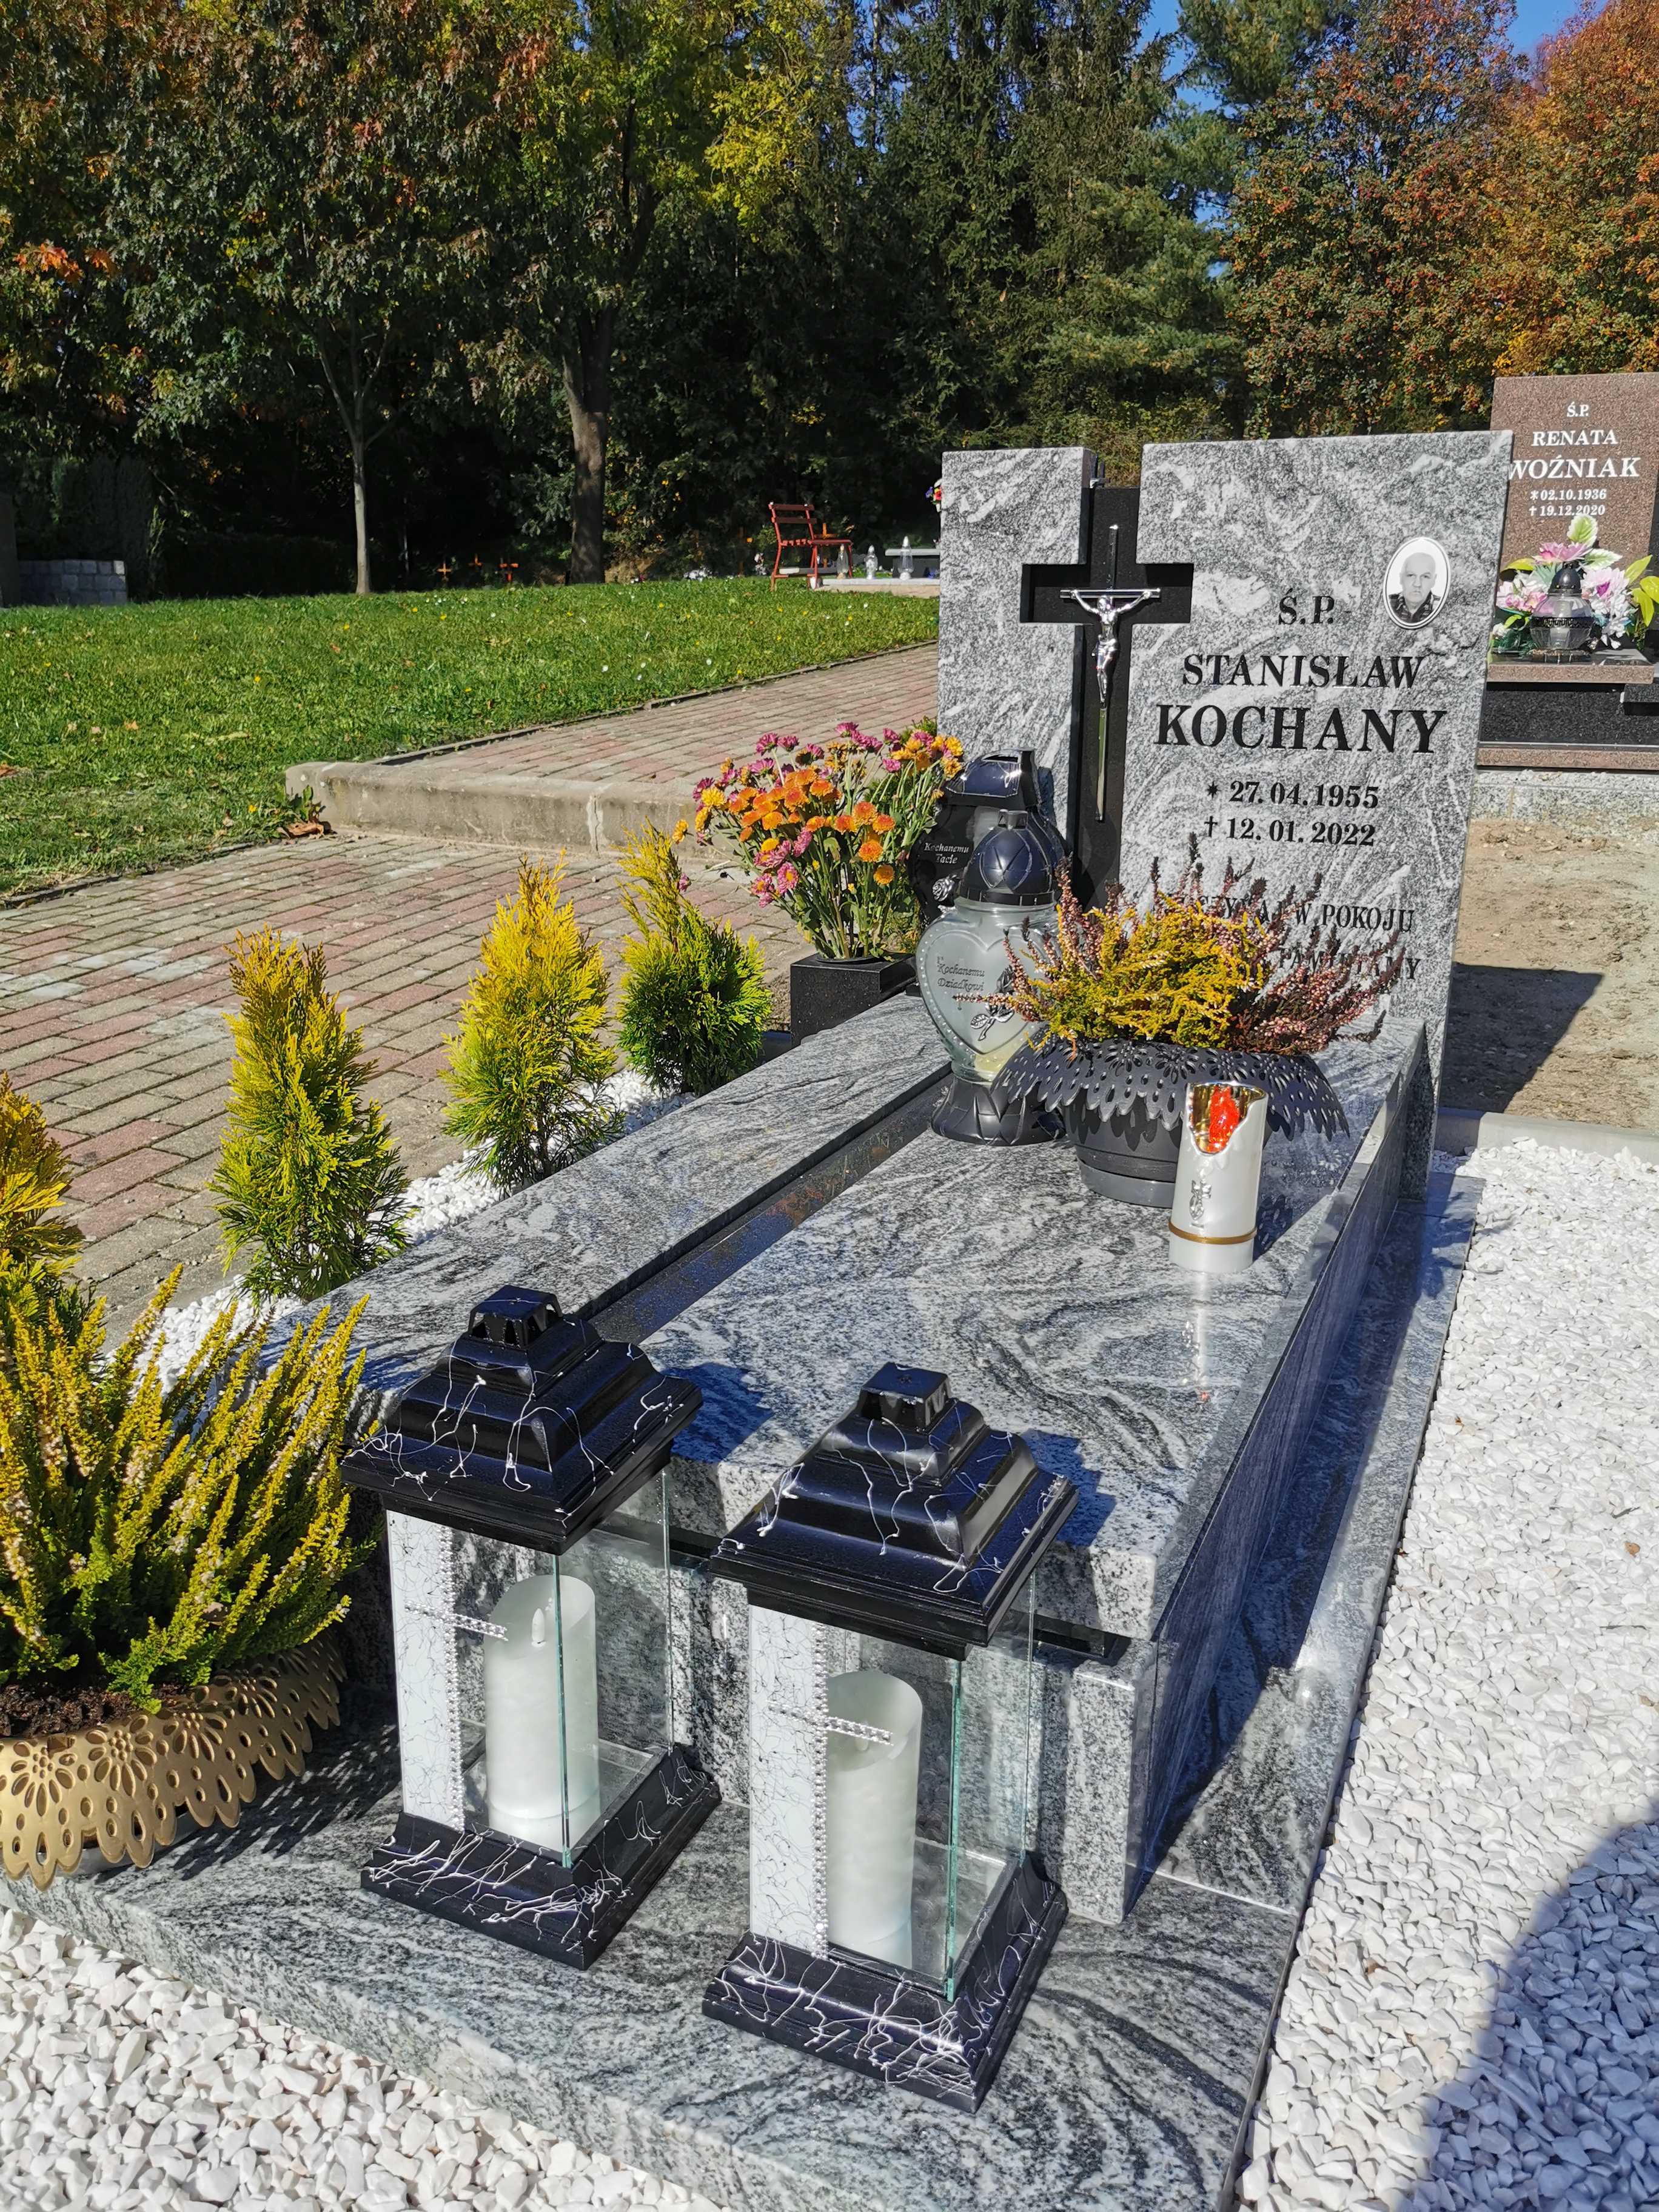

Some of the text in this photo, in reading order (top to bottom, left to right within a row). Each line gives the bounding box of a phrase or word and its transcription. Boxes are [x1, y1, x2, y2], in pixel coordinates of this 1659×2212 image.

[1567, 401, 1589, 417] Ś.P.
[1531, 429, 1619, 446] RENATA
[1509, 455, 1641, 480] WOŹNIAK
[1540, 489, 1607, 500] 02.10.1936
[1540, 504, 1606, 516] 19.12.2020
[1278, 588, 1335, 625] Ś.P.
[1182, 654, 1426, 689] STANISŁAW
[1153, 704, 1448, 754] KOCHANY
[923, 842, 970, 853] Kochanemu
[936, 853, 958, 864] Tacie
[1322, 903, 1415, 933] POKOJU
[937, 964, 985, 977] Kochanemu
[937, 977, 984, 992] Dziadkowi
